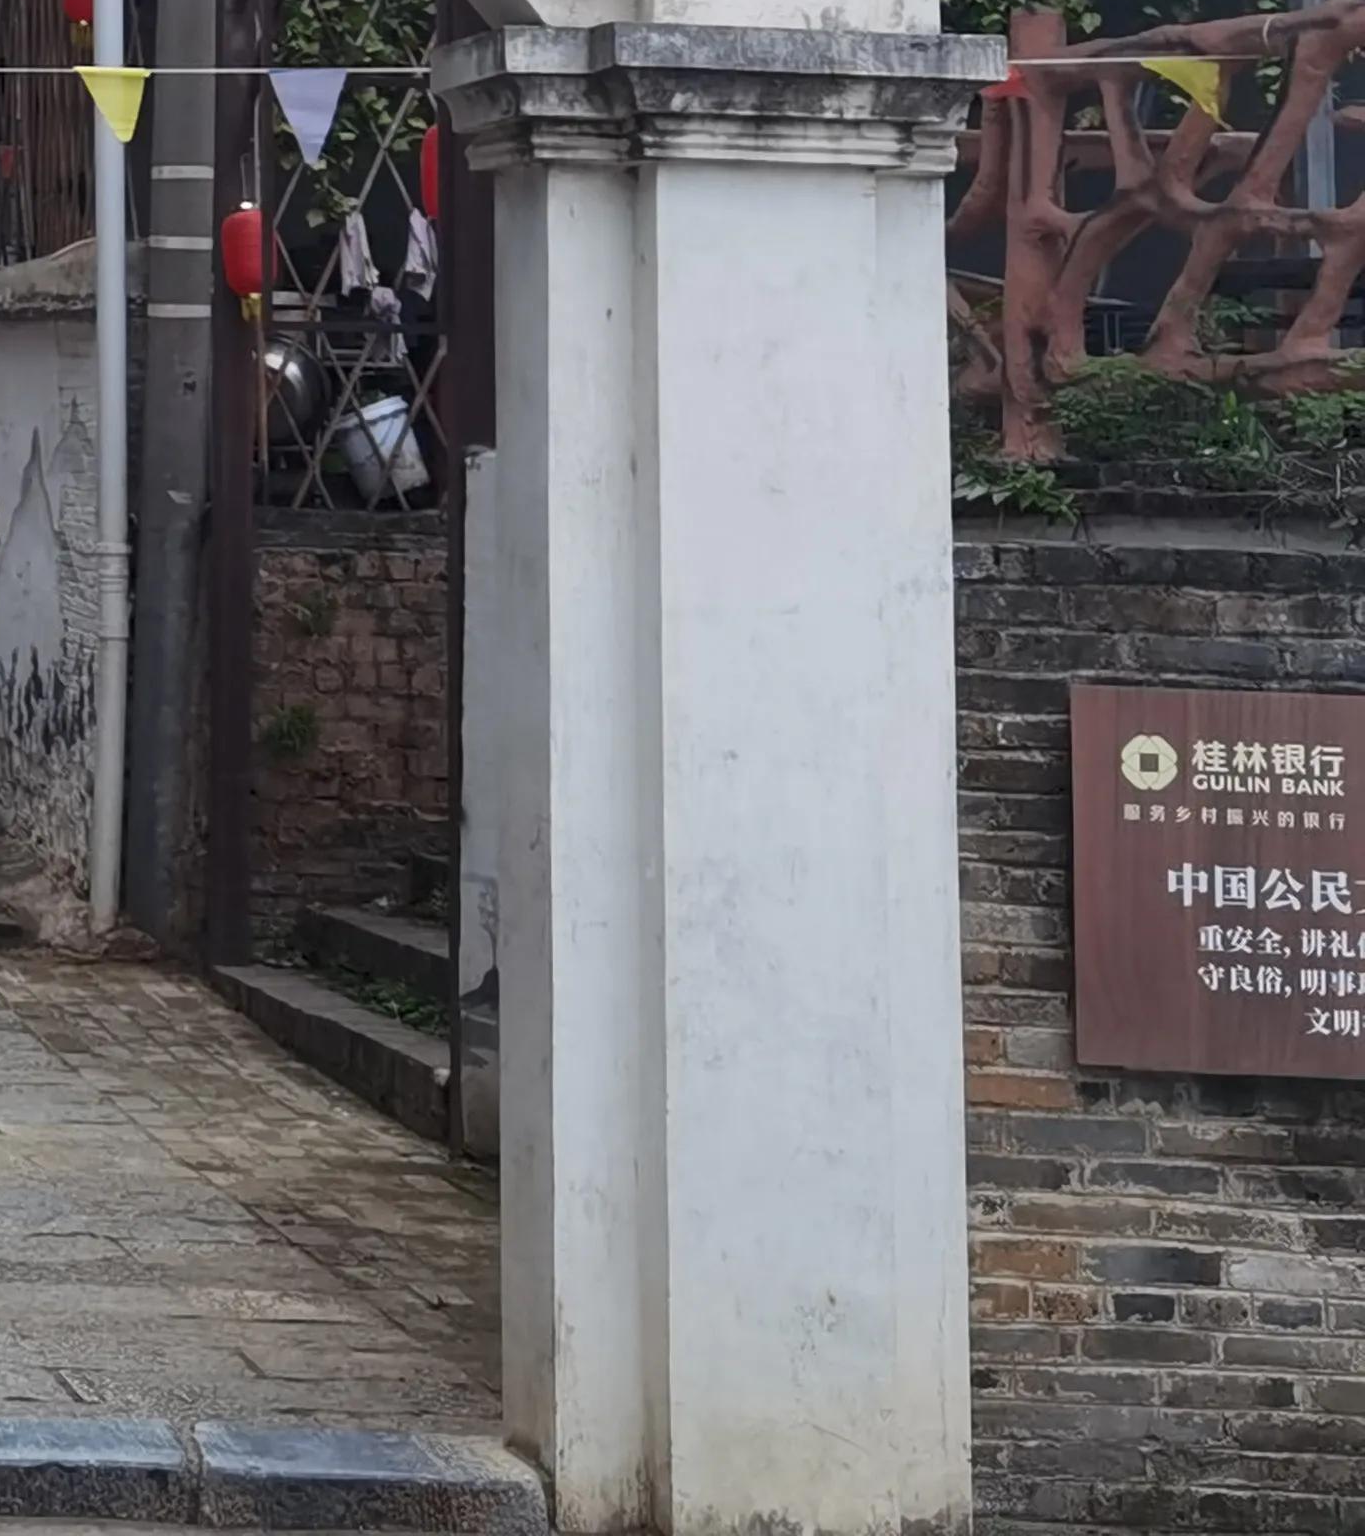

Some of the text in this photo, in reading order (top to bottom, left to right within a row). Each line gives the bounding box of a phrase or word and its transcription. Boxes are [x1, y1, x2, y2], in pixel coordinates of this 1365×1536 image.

[1191, 740, 1346, 778] 桂林银行
[1192, 775, 1345, 797] GUILIN BANK
[1123, 804, 1346, 831] 服务乡村振兴的银行
[1167, 862, 1365, 914] 中国公民
[1304, 1007, 1365, 1037] 文明
